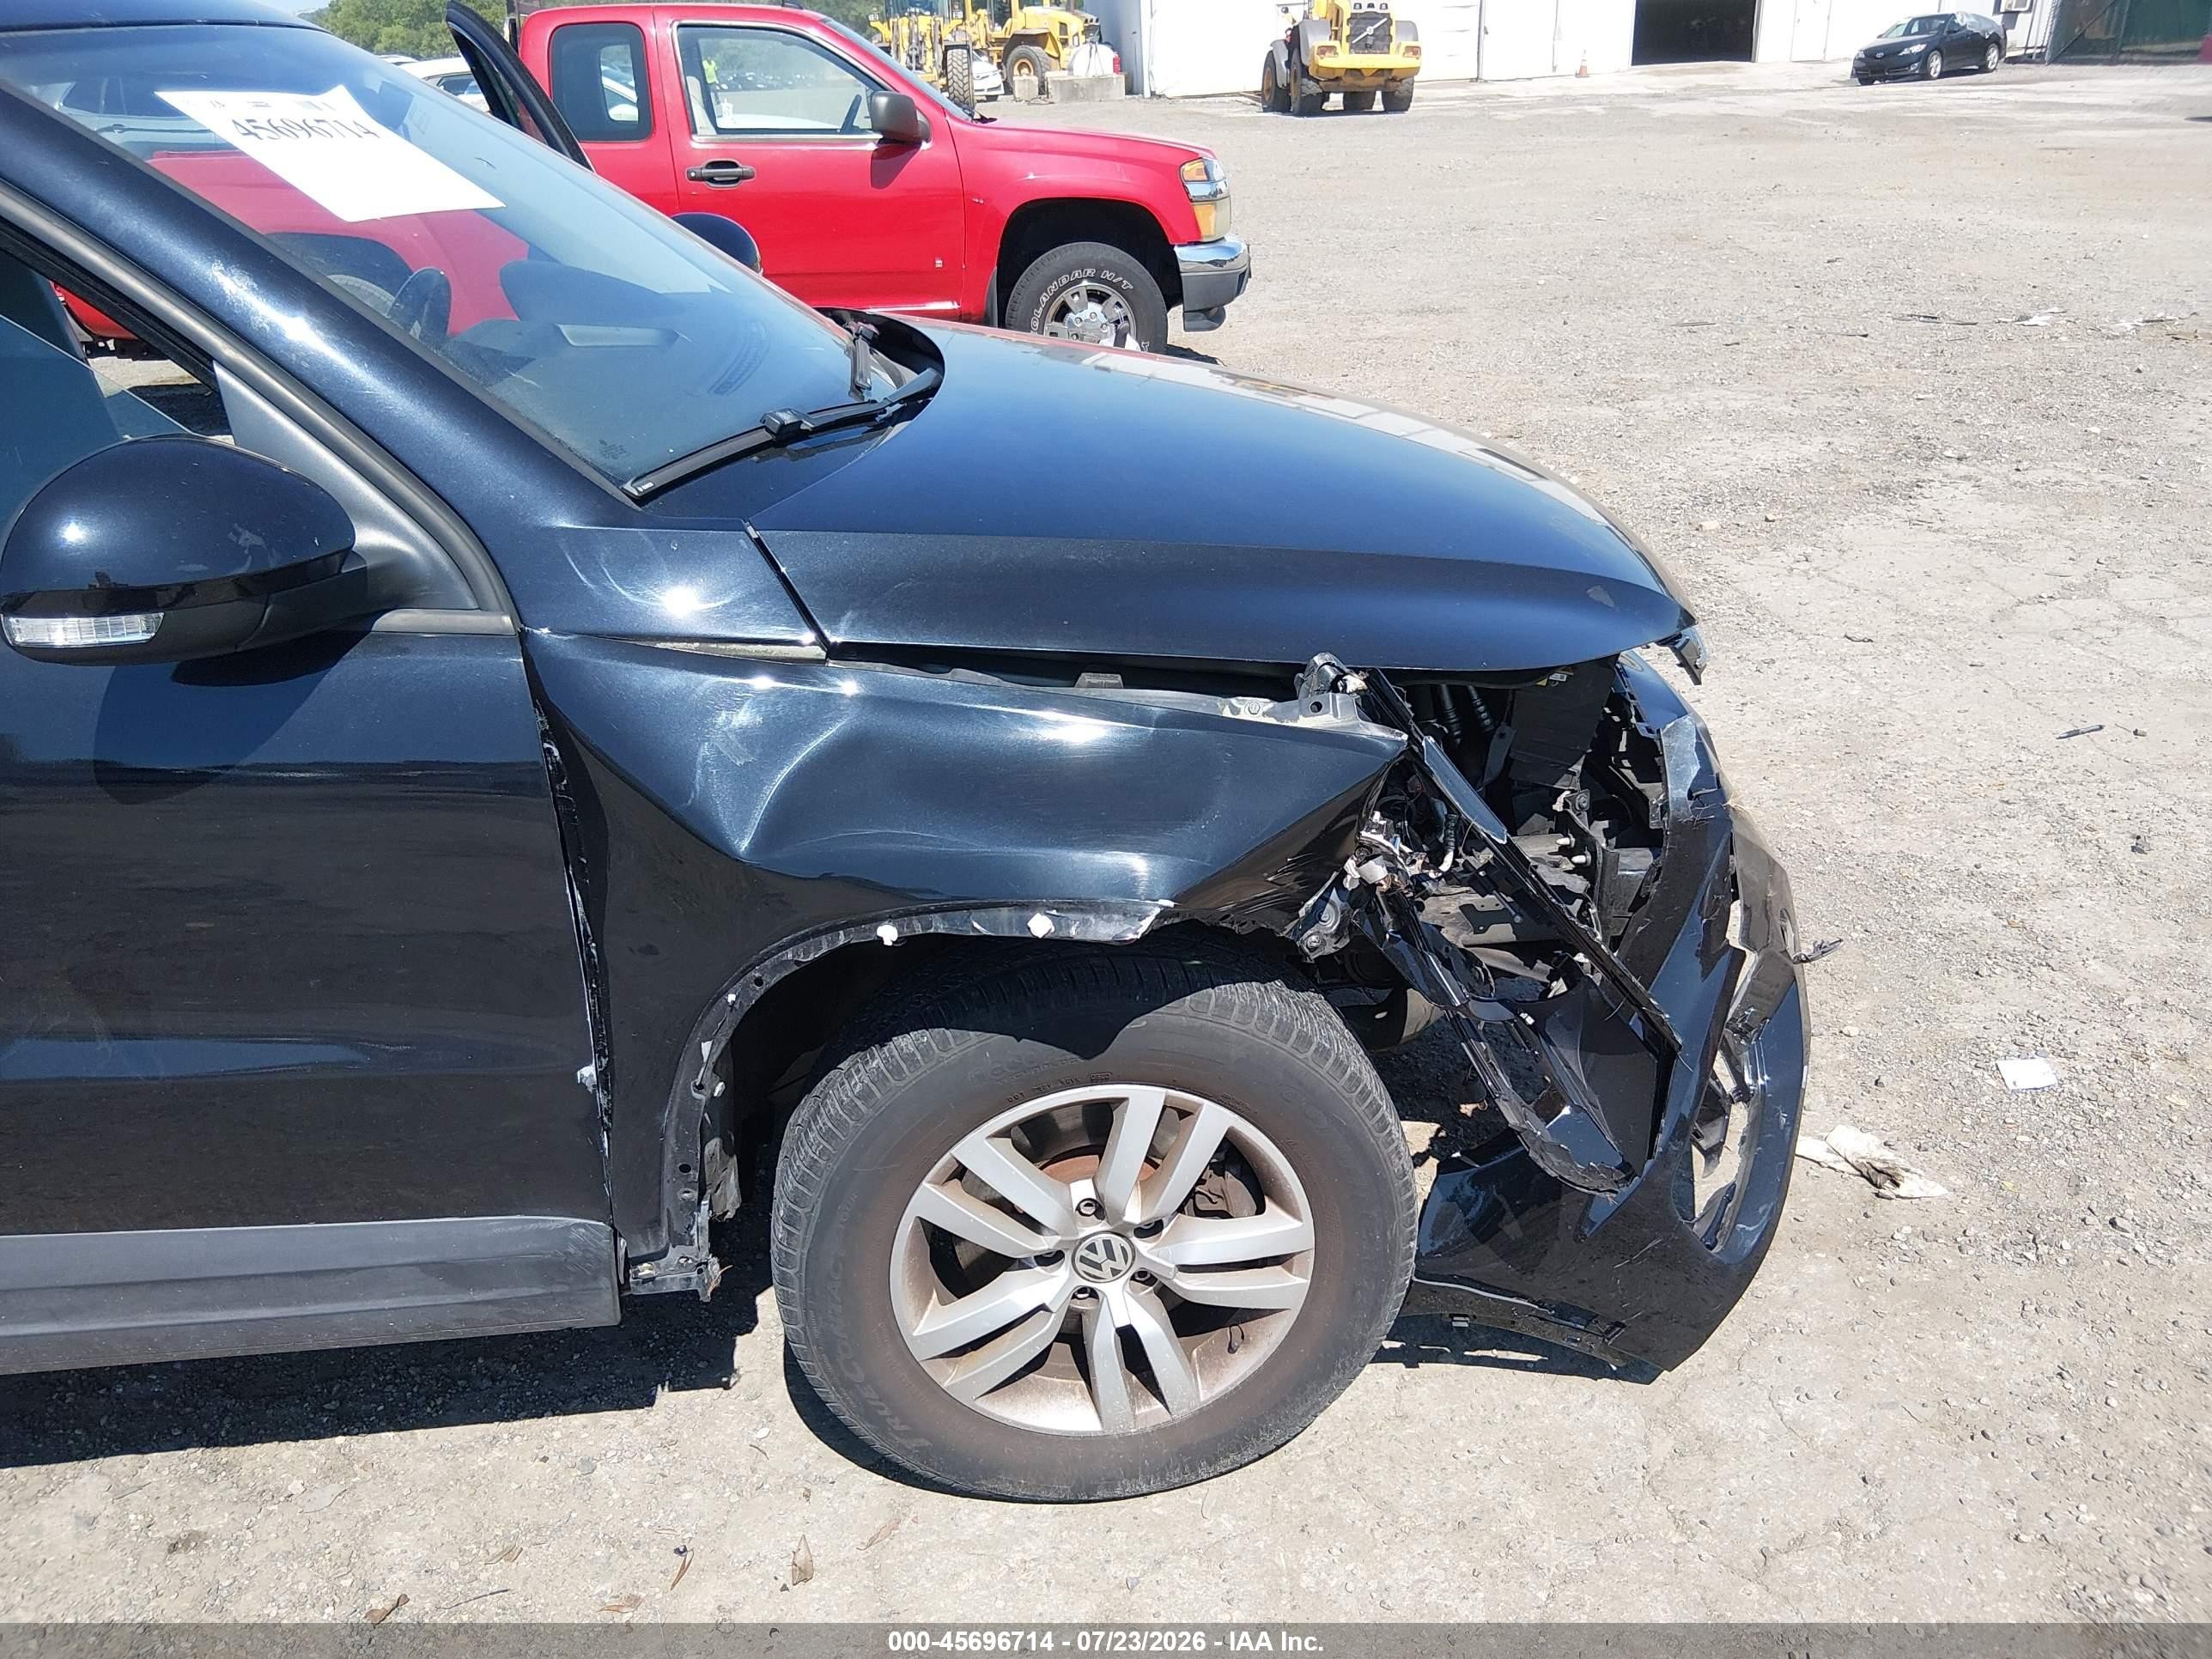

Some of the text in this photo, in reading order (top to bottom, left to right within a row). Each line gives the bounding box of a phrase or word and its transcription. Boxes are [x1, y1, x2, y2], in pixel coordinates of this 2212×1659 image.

[231, 118, 380, 140] 45696714
[1030, 268, 1133, 336] OLANDAR H/T
